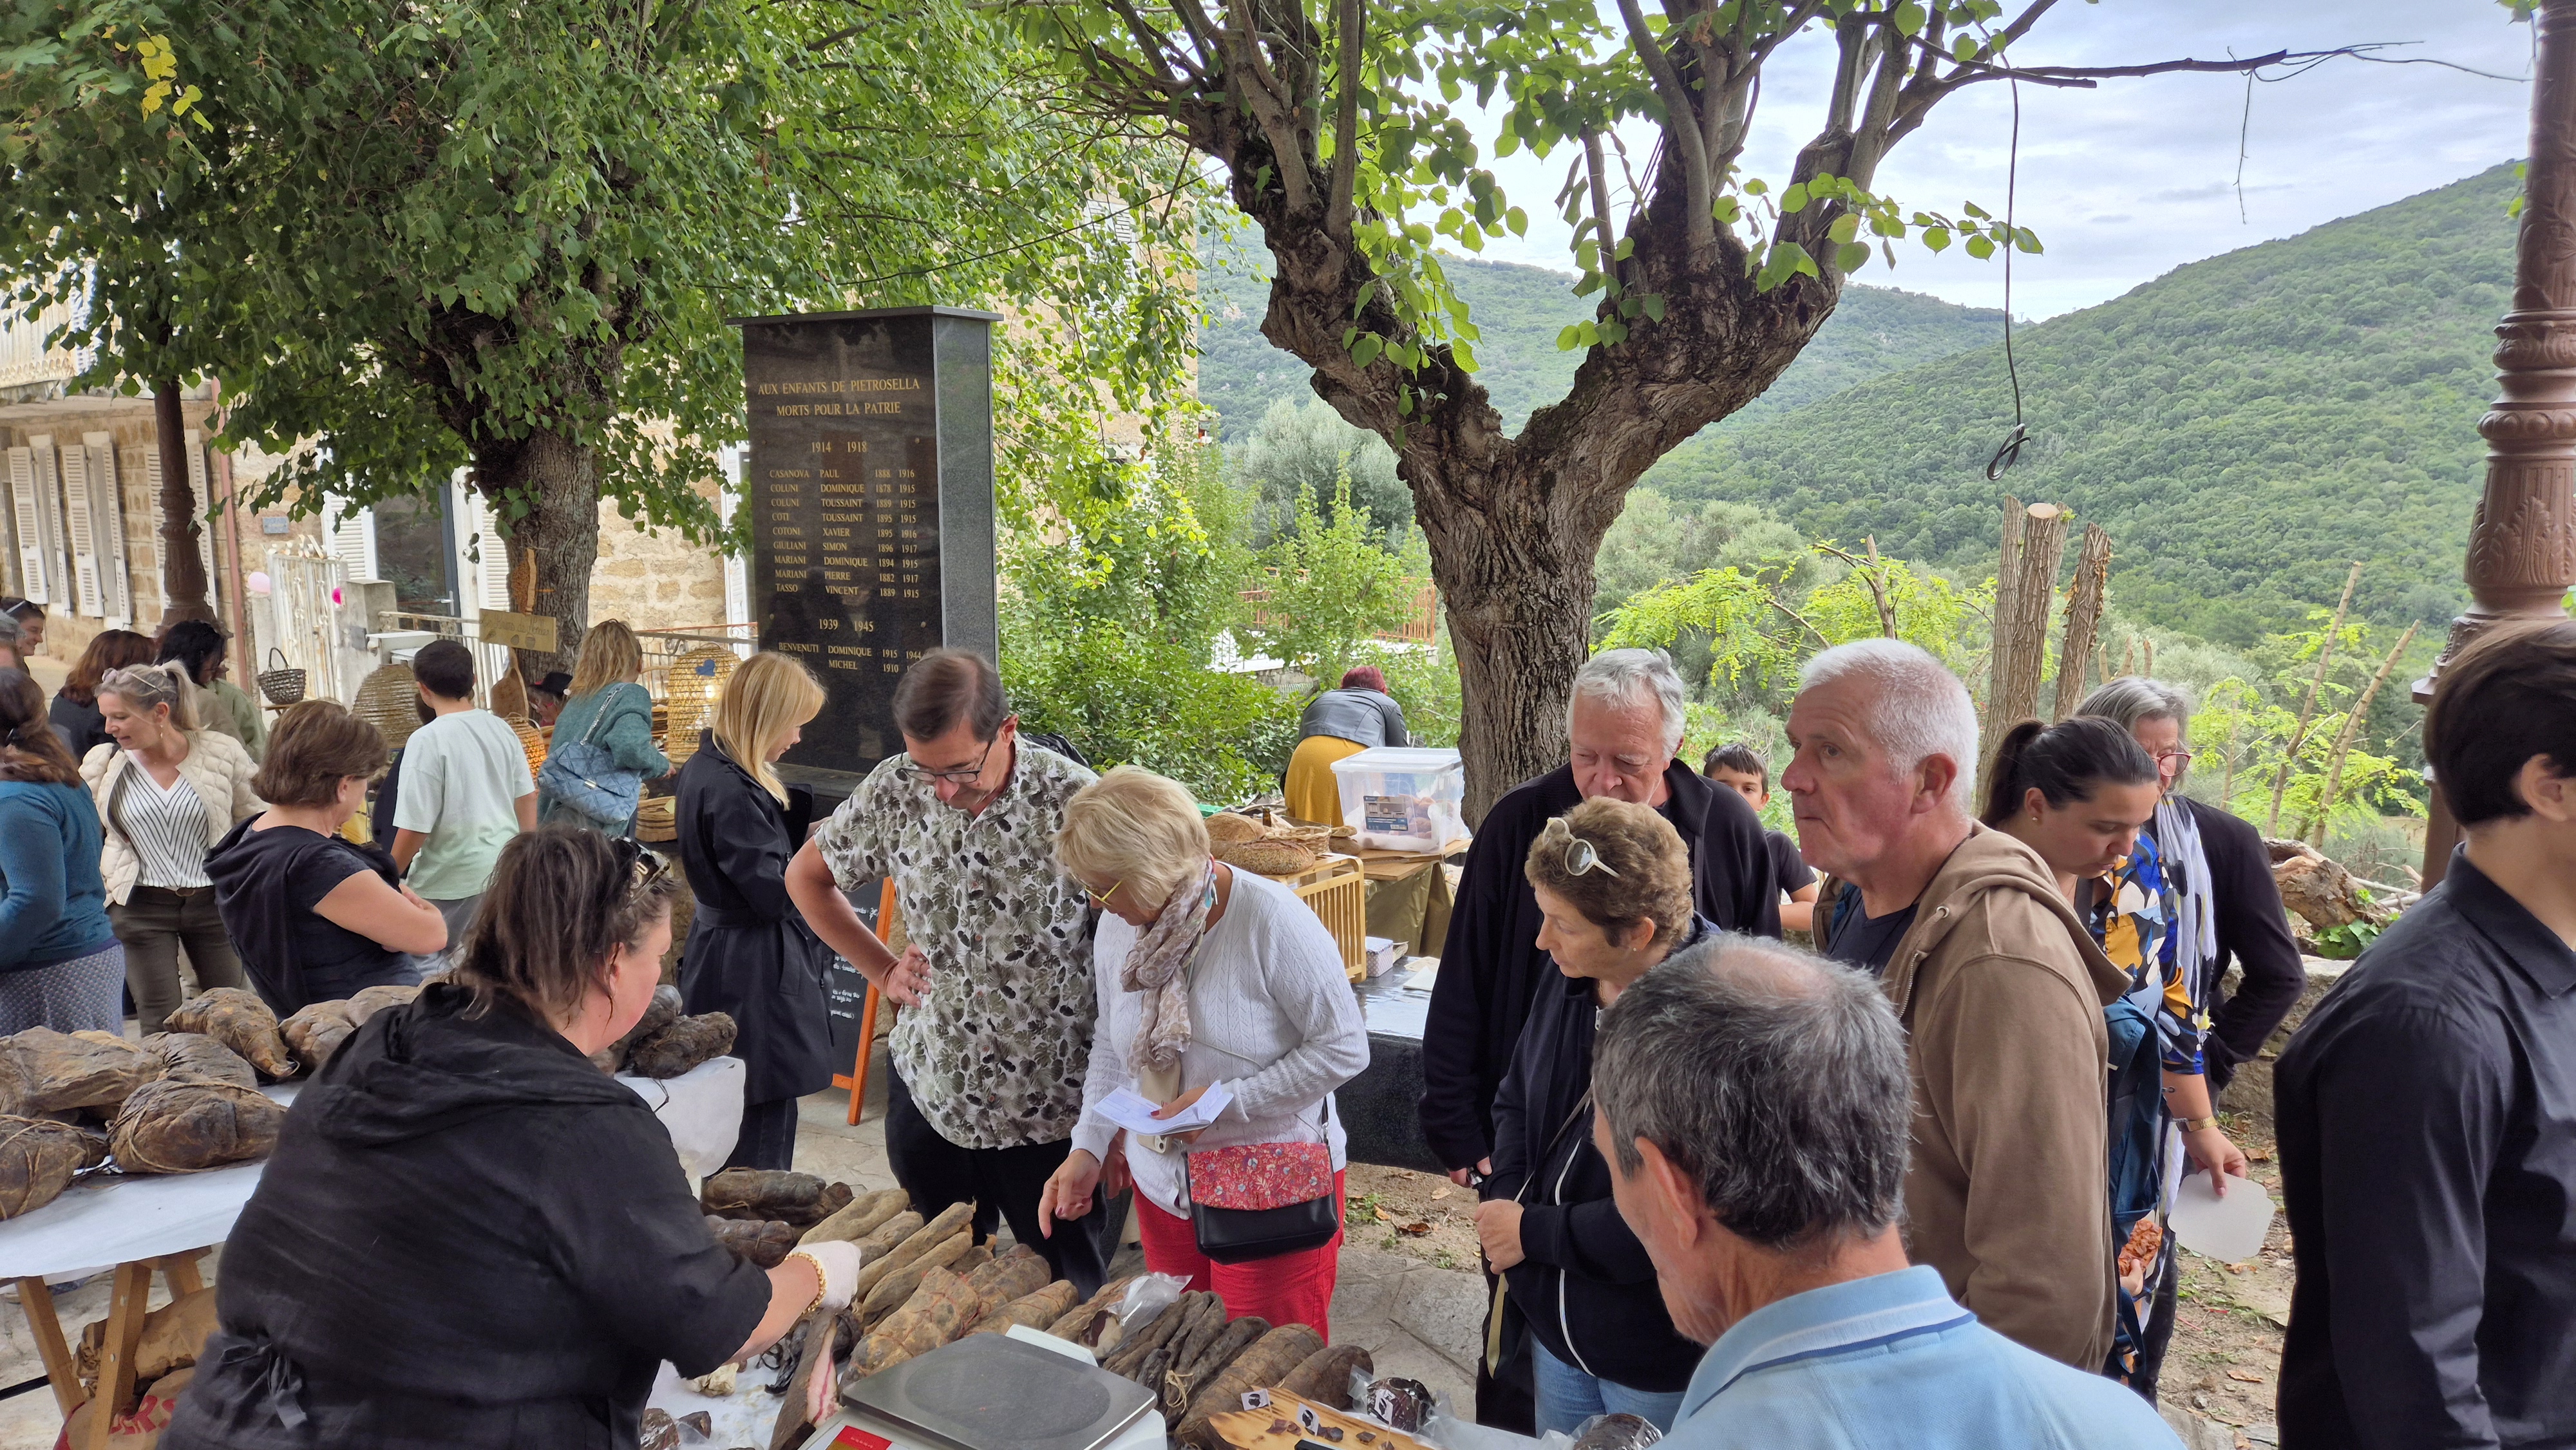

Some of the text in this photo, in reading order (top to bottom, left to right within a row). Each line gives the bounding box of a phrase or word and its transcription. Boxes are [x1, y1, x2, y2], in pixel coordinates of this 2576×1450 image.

[757, 378, 920, 395] AUX ENFANTS DE PIETROSELLA
[776, 401, 901, 417] MORTS POUR LA PATRIE
[811, 440, 867, 453] 1914 1918
[770, 469, 914, 479] CASANOVA PAUL 1888 1916
[770, 484, 915, 494] COLUNI DOMINIQUE 1878 1915
[772, 498, 916, 509] COLUNI TOUSSAINT 1889 1915
[772, 513, 916, 523] COTI TOUSSAINT 1895 1915
[773, 527, 917, 539] COTONI XAVIER 1895 1916
[773, 541, 918, 554] GIULIANI SIMON 1896 1917
[774, 555, 918, 569] MARIANI DOMINIQUE 1894 1915
[775, 569, 918, 583] MARIANI PIERRE 1882 1917
[775, 583, 919, 598] TASSO VINCENT 1889 1915
[819, 618, 874, 632] 1939 1945
[778, 642, 922, 660] BENVENUTI DOMINIQUE 1915 1944
[828, 659, 858, 670] MICHEL
[883, 664, 899, 673] 1910
